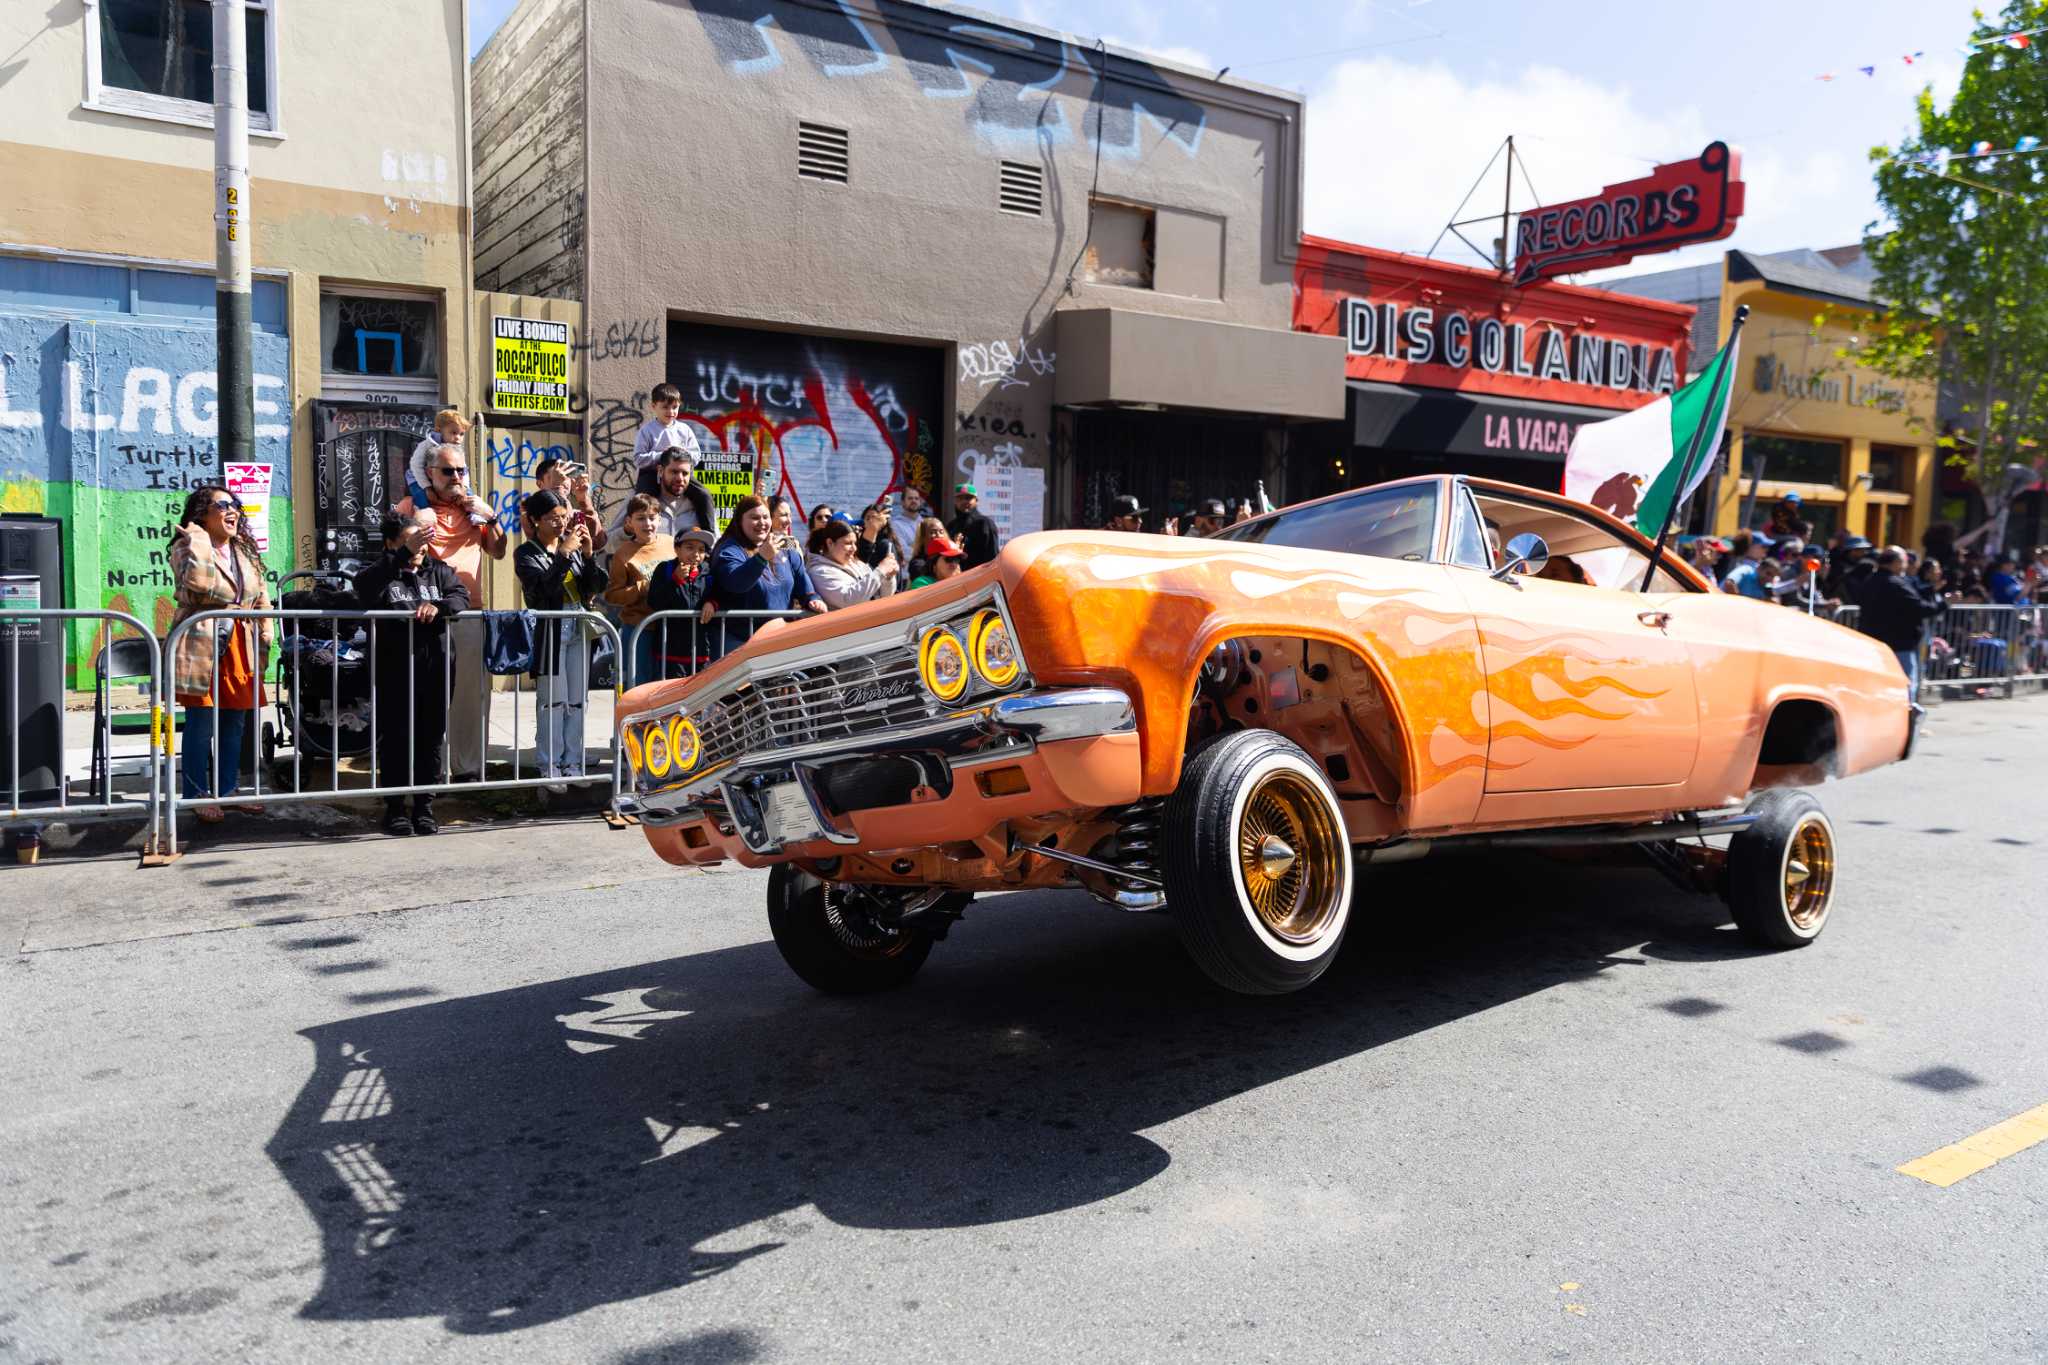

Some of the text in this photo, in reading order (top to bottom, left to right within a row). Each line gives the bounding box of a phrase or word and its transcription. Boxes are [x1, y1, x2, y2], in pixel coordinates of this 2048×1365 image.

[1516, 184, 1700, 258] RECORDS
[497, 319, 566, 342] LIVE BOXING
[519, 340, 541, 350] AT THE
[1345, 297, 1677, 395] DISCOLANDIA
[496, 349, 566, 377] ROCCAPULCO
[497, 379, 565, 396] FRIDAY JUNE 6
[497, 394, 565, 411] HITFITSF.COM
[1484, 414, 1570, 454] LA VACA
[118, 444, 213, 467] Turtle
[740, 455, 752, 463] DE
[704, 462, 742, 471] LEYENDAS
[145, 470, 219, 490] Islan
[697, 471, 751, 486] AMERICA
[165, 502, 182, 515] is
[711, 493, 745, 508] HIVA
[108, 569, 174, 588] North
[843, 680, 912, 707] Chevrolet
